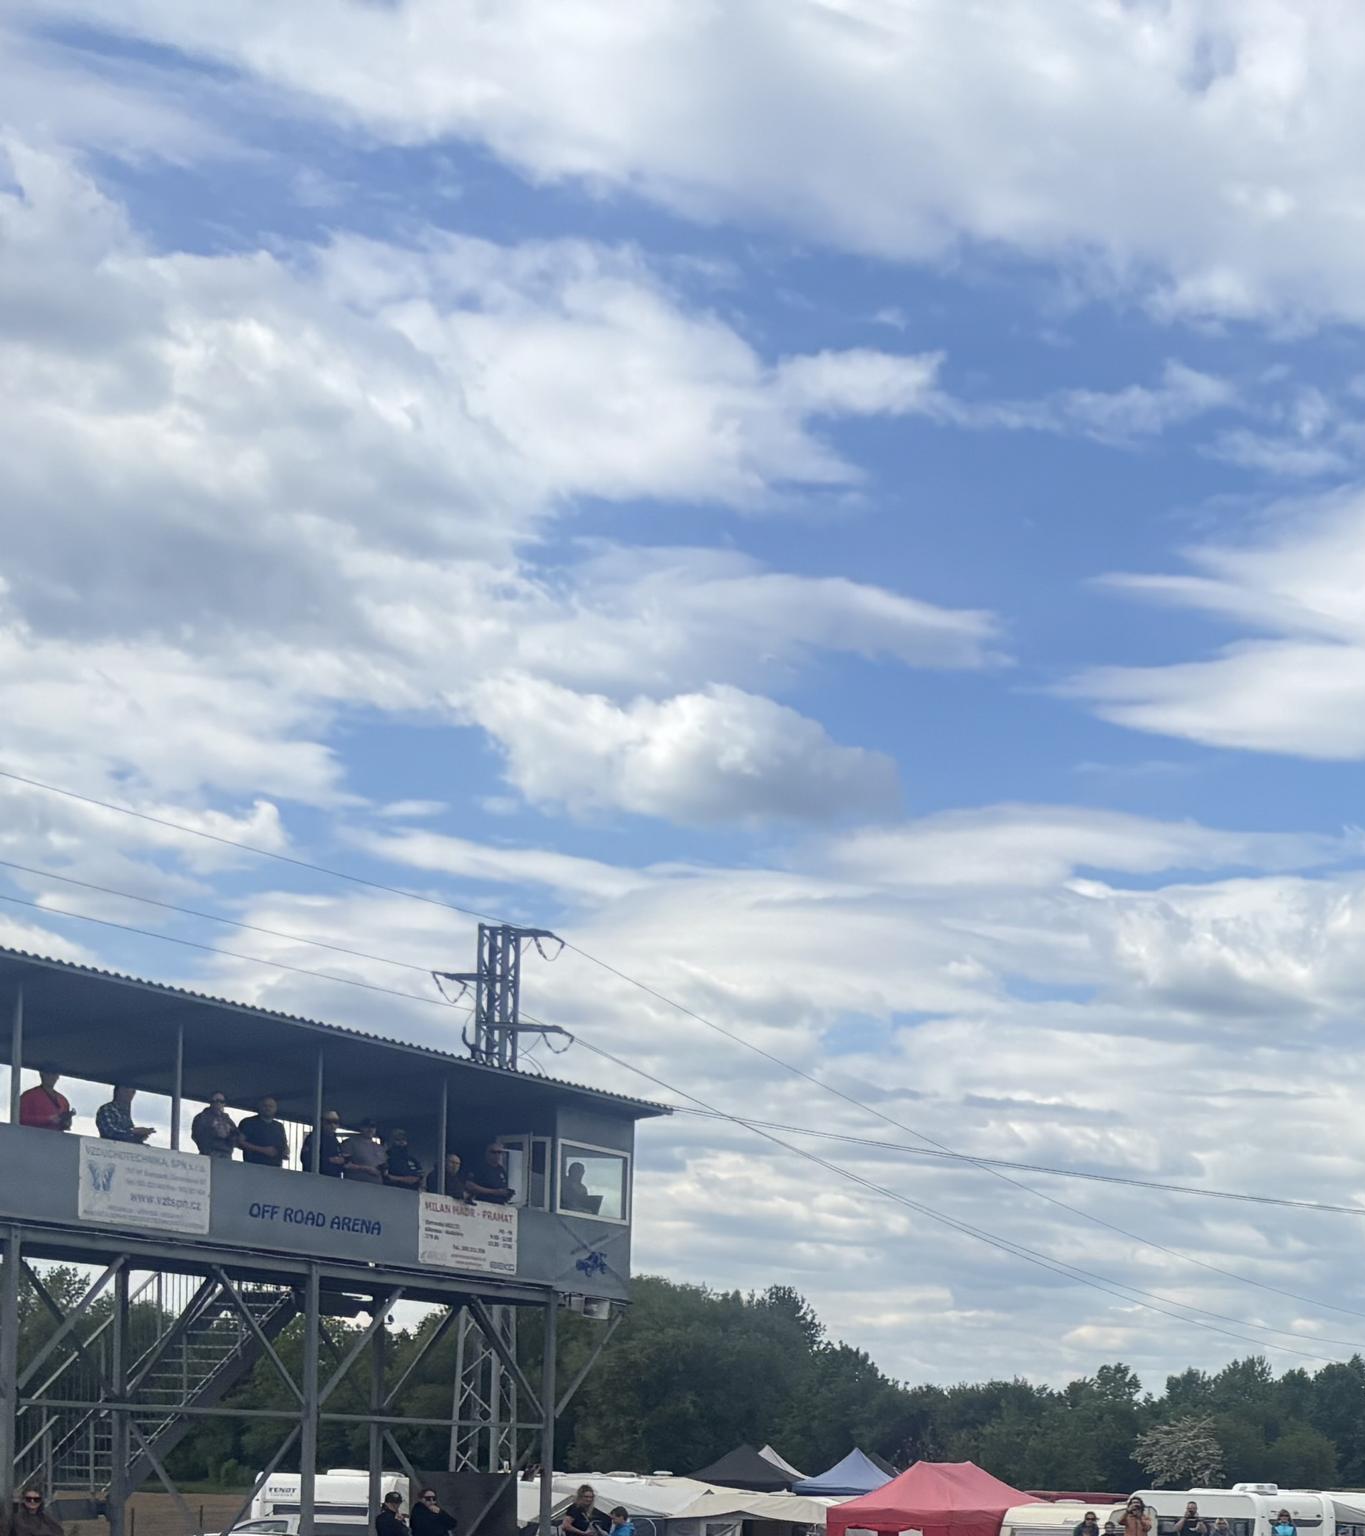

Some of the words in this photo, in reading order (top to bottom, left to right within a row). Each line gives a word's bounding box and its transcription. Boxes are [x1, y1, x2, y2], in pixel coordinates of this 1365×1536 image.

[249, 1202, 280, 1220] OFF
[283, 1207, 326, 1228] ROAD
[330, 1215, 382, 1236] ARENA
